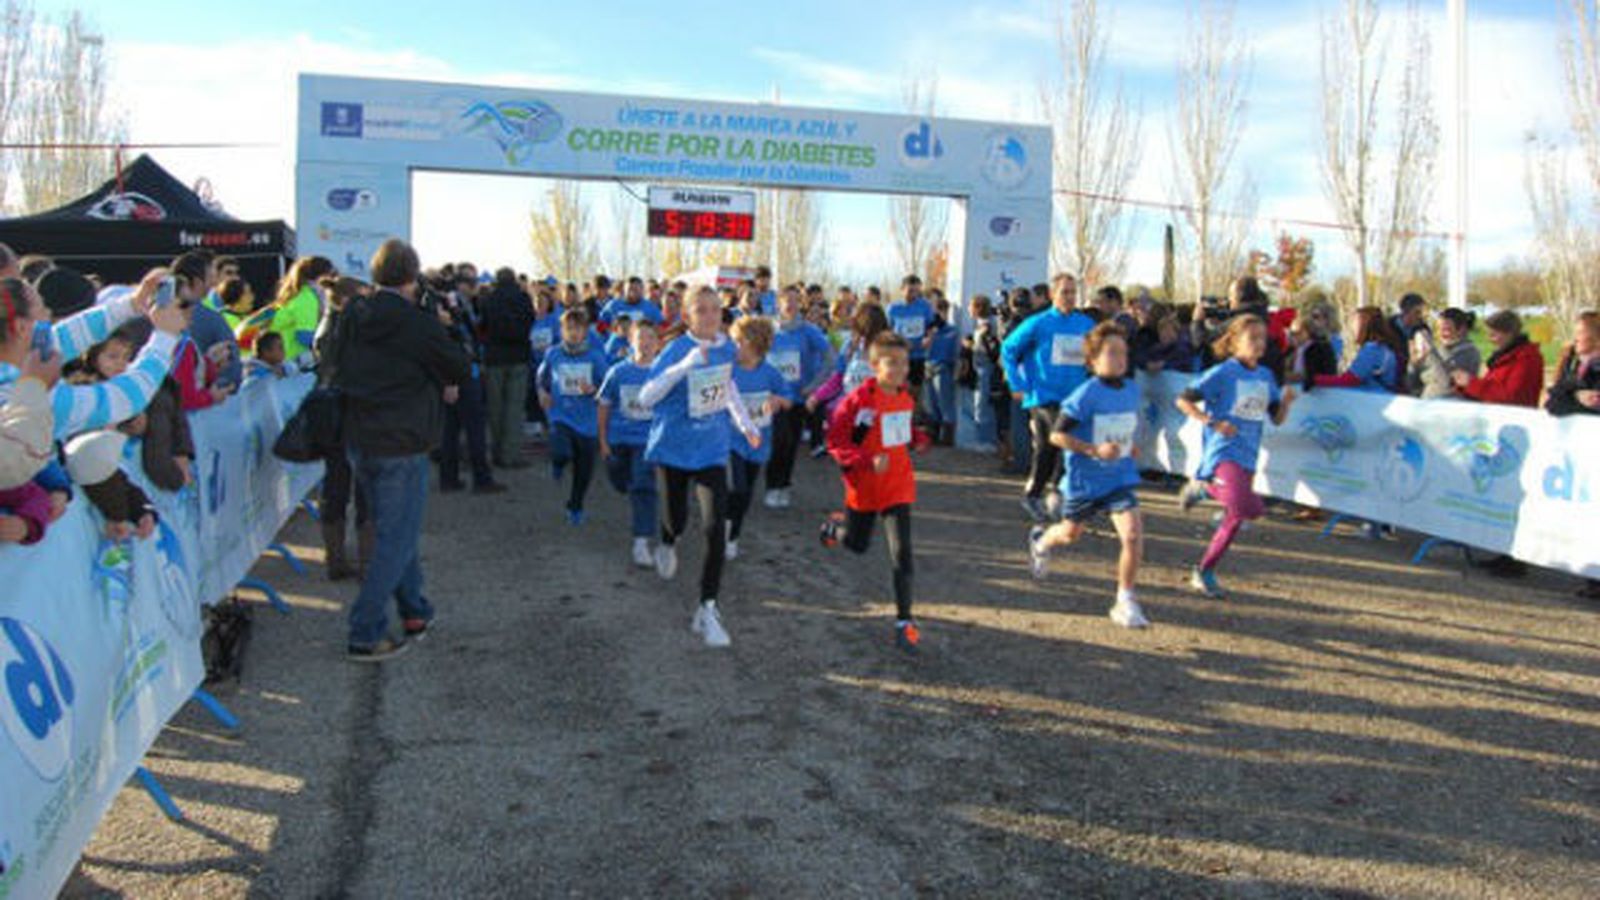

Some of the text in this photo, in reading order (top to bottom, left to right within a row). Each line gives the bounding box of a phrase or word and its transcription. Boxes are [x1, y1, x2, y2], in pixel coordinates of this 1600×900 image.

[699, 112, 721, 130] LA
[726, 113, 791, 135] MARCA
[567, 126, 876, 170] CORRE POR LA DIABETES
[179, 229, 269, 246] forevent.es
